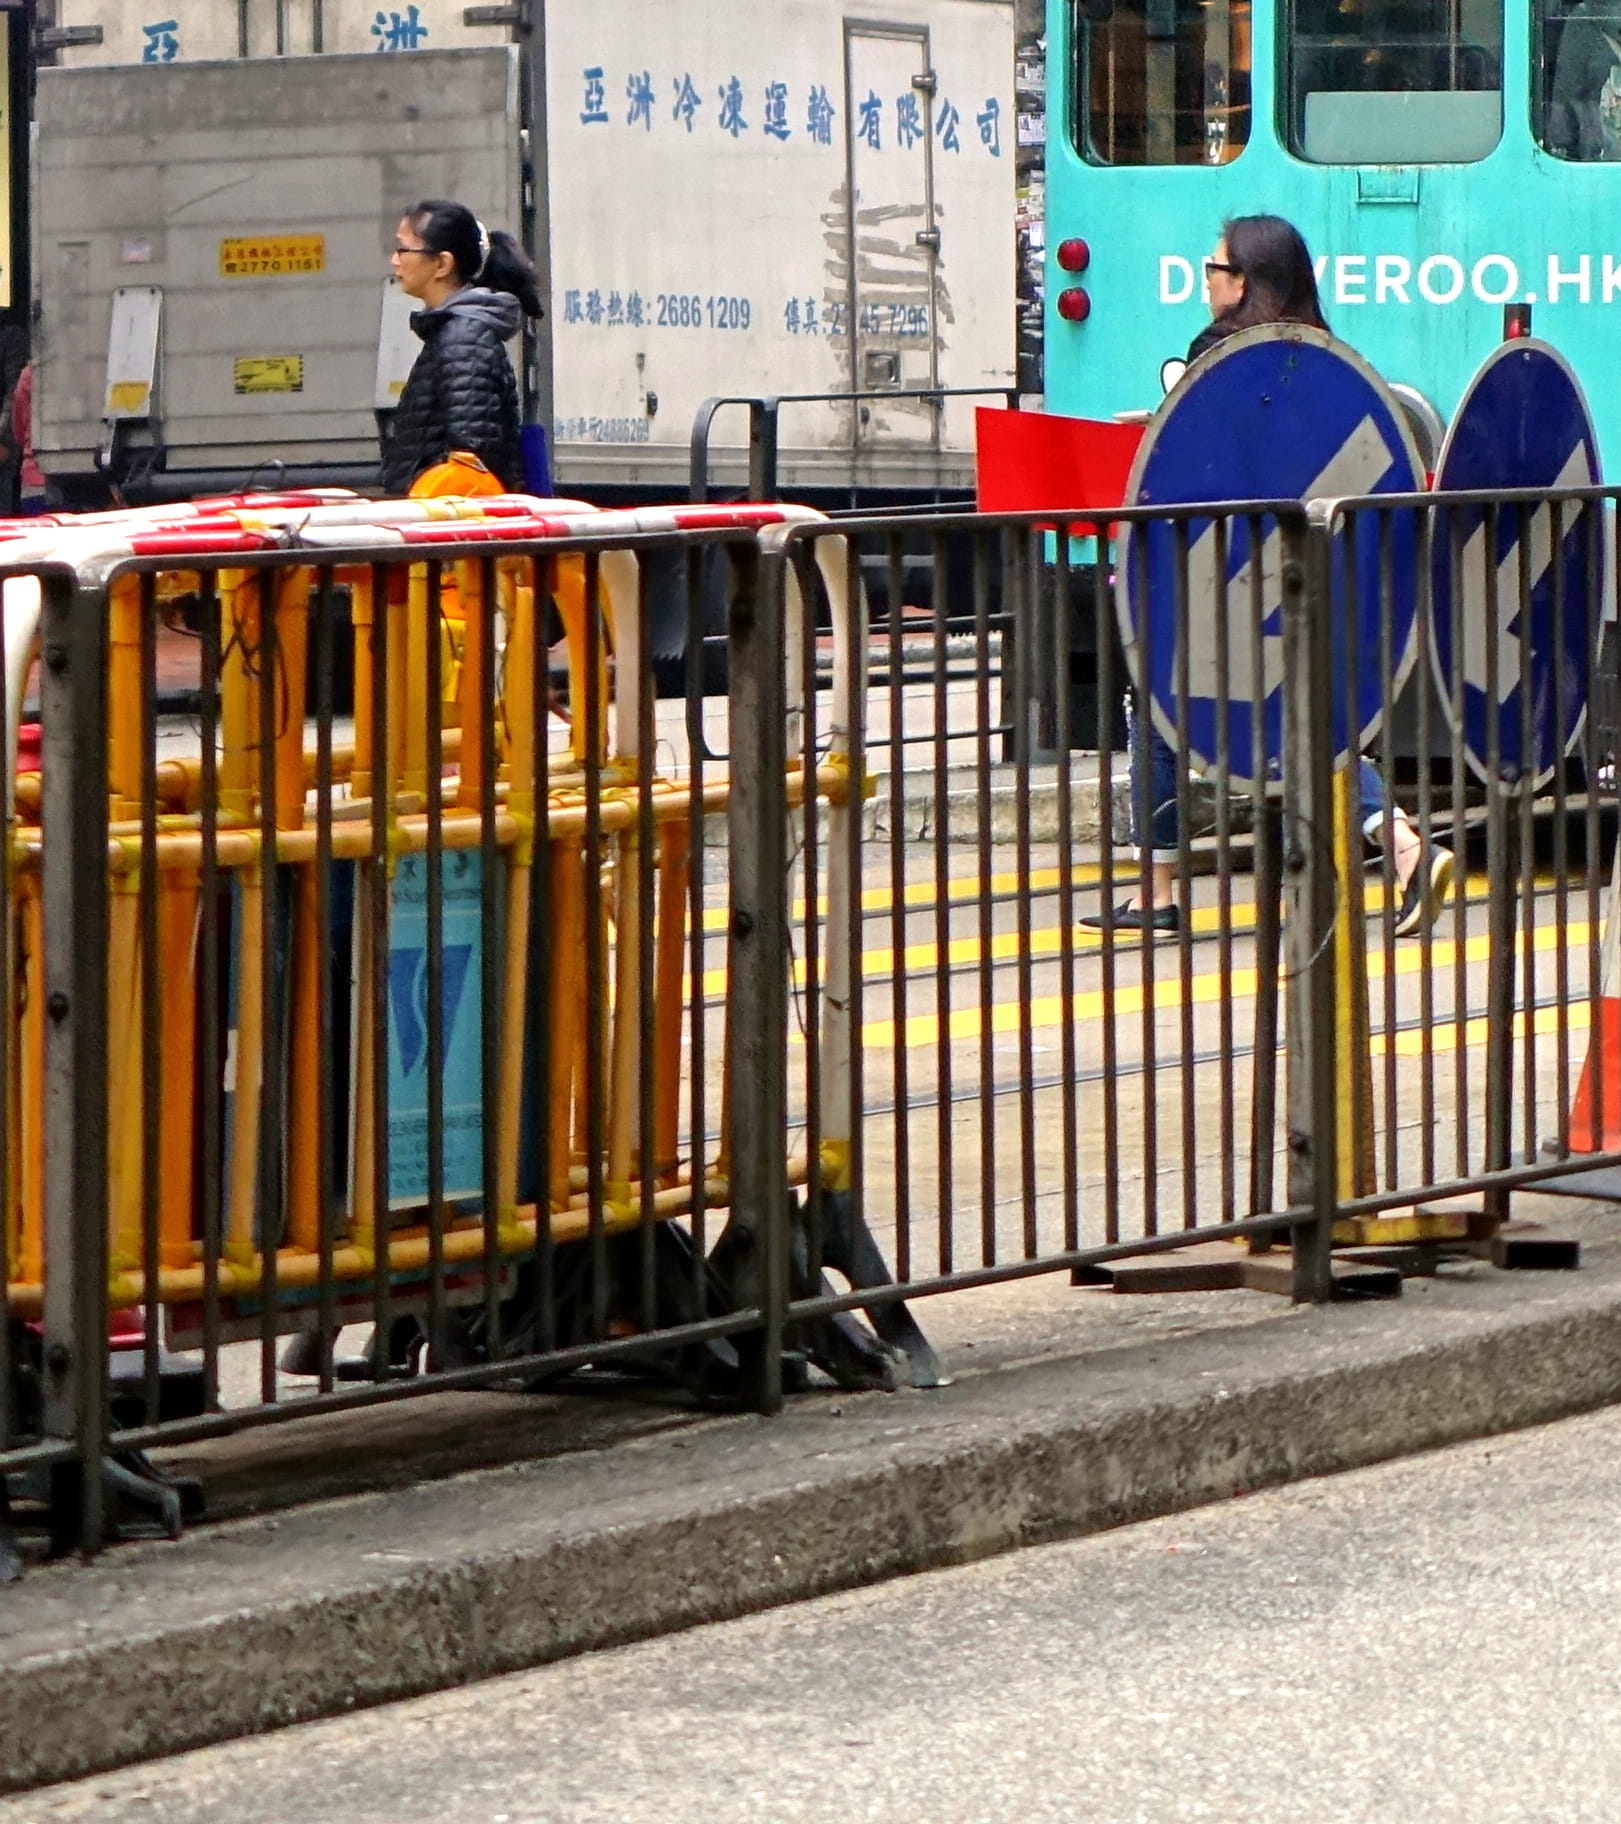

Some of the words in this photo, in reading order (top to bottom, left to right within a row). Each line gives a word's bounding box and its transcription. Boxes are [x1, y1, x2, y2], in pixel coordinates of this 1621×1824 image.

[580, 66, 1002, 157] 亞洲冷凍運輸有限公司
[656, 293, 702, 328] 2686
[706, 296, 752, 330] 1209
[831, 303, 880, 334] 245
